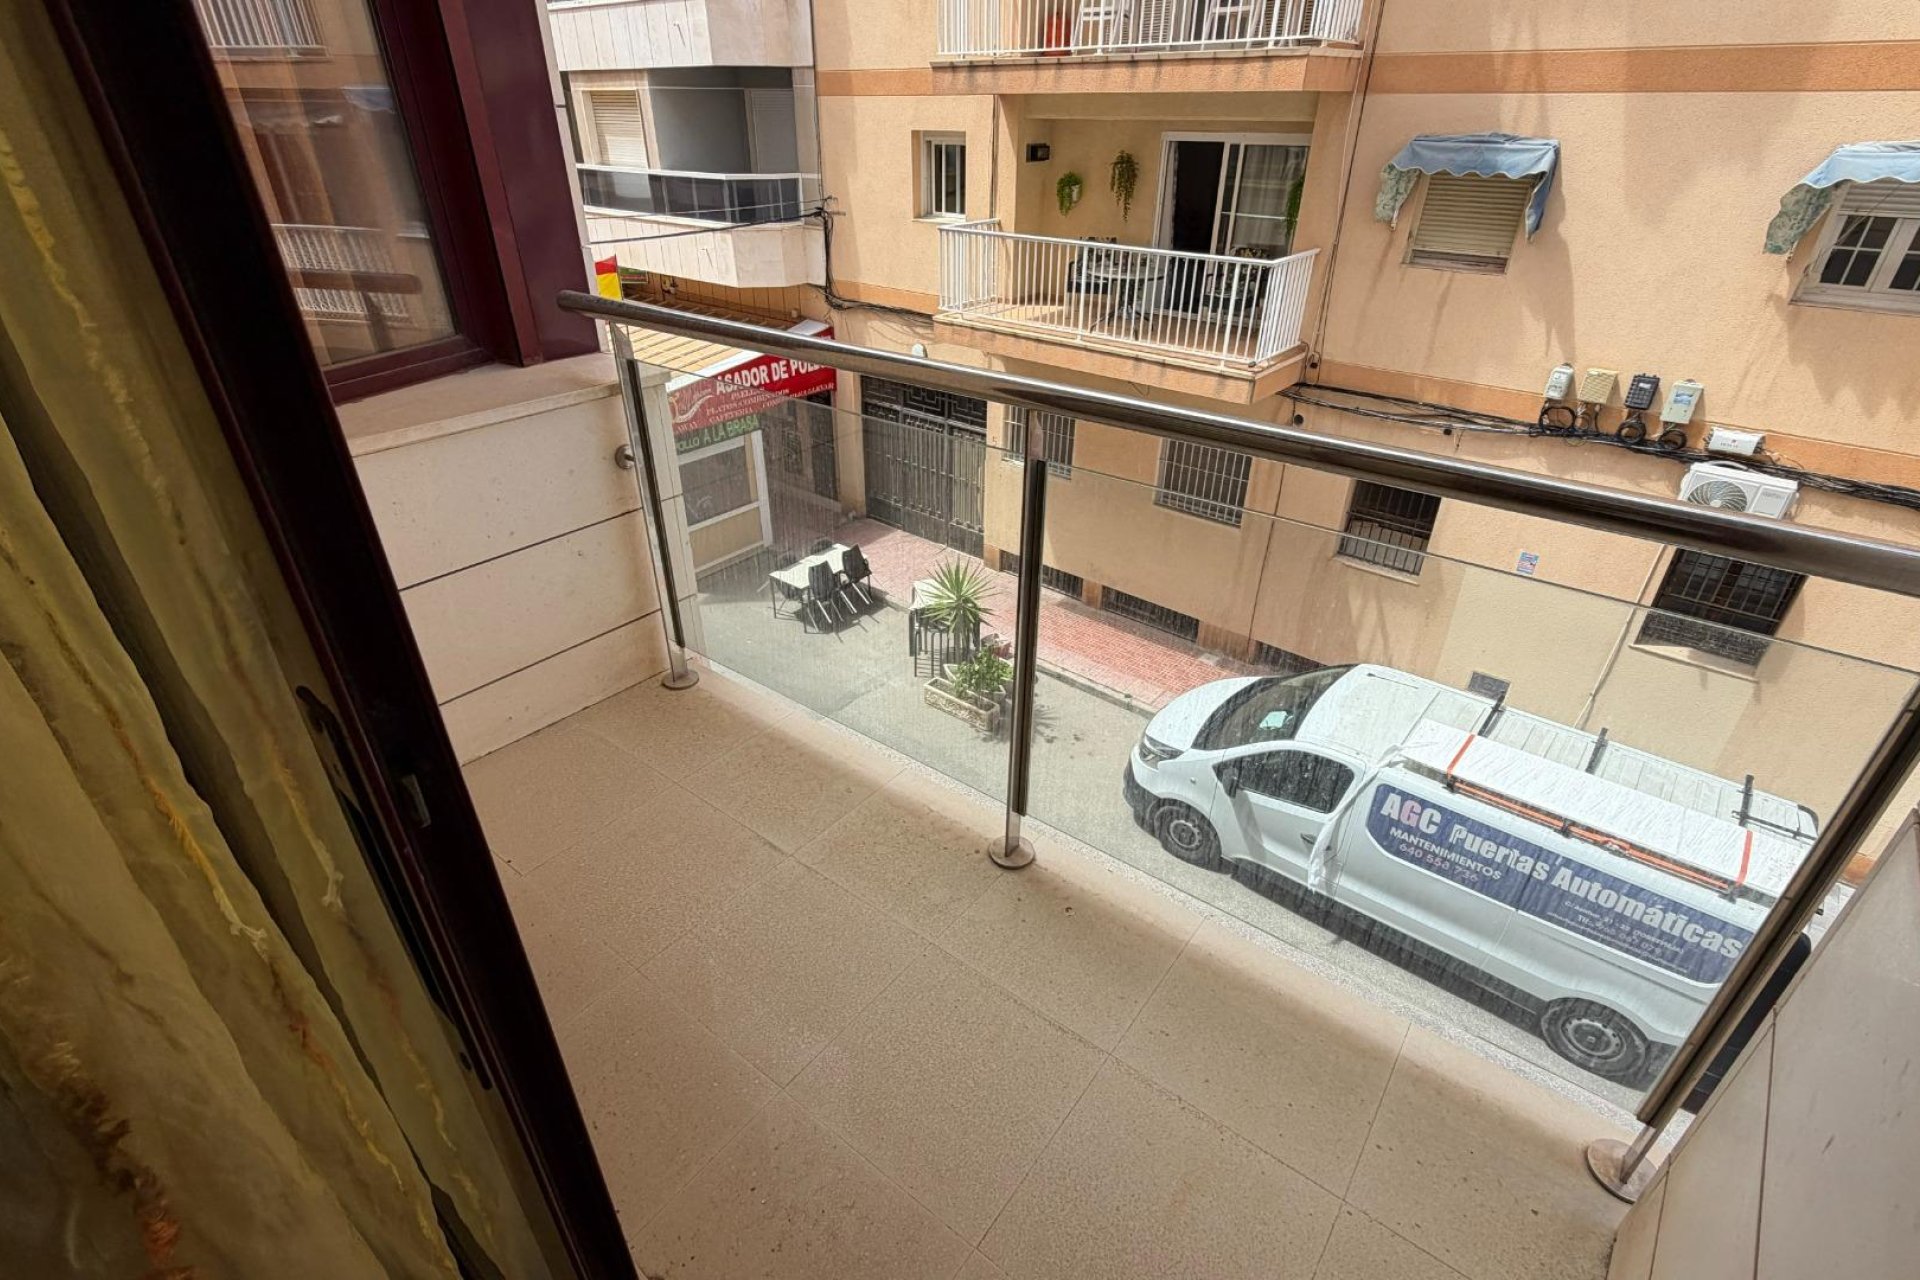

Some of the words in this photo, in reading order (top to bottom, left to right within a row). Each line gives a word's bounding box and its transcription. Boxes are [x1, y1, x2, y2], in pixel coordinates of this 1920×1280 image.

[716, 364, 770, 395] ASADOR
[770, 359, 789, 382] DE
[706, 401, 738, 416] PLATOS
[676, 436, 700, 451] OLLO
[703, 427, 712, 446] A
[712, 421, 727, 442] LA
[726, 413, 759, 437] BRASA
[1389, 826, 1502, 880] MANTENIMIENTOS
[1380, 793, 1442, 834] AGC
[1449, 823, 1550, 881] Puertas
[1551, 865, 1744, 959] Automáticas
